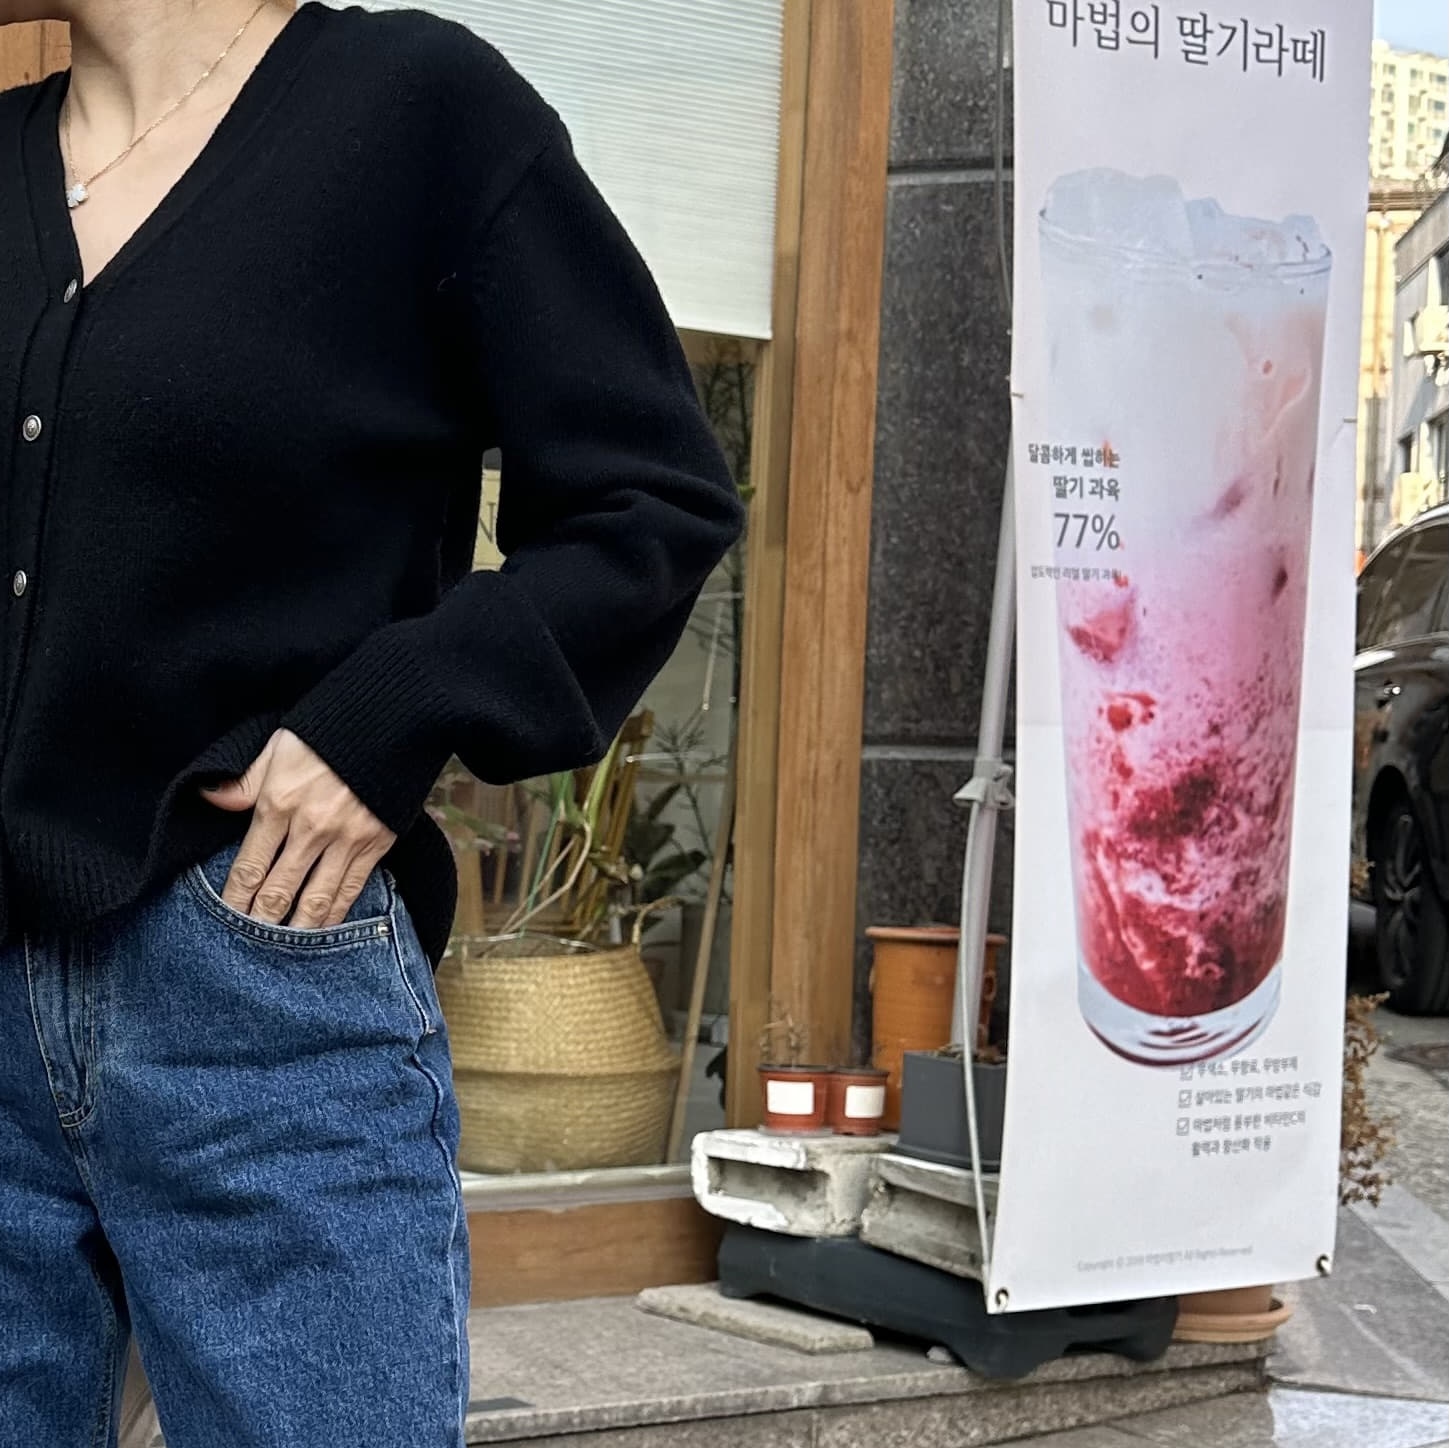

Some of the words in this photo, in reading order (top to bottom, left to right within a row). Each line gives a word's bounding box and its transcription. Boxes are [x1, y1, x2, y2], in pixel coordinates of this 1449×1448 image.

[1047, 0, 1159, 58] 마법의
[1177, 12, 1326, 82] 딸기라떼
[1028, 443, 1077, 465] 달콤하게
[1053, 475, 1084, 499] 딸기
[1089, 477, 1120, 501] 과육
[1054, 512, 1120, 551] 77%
